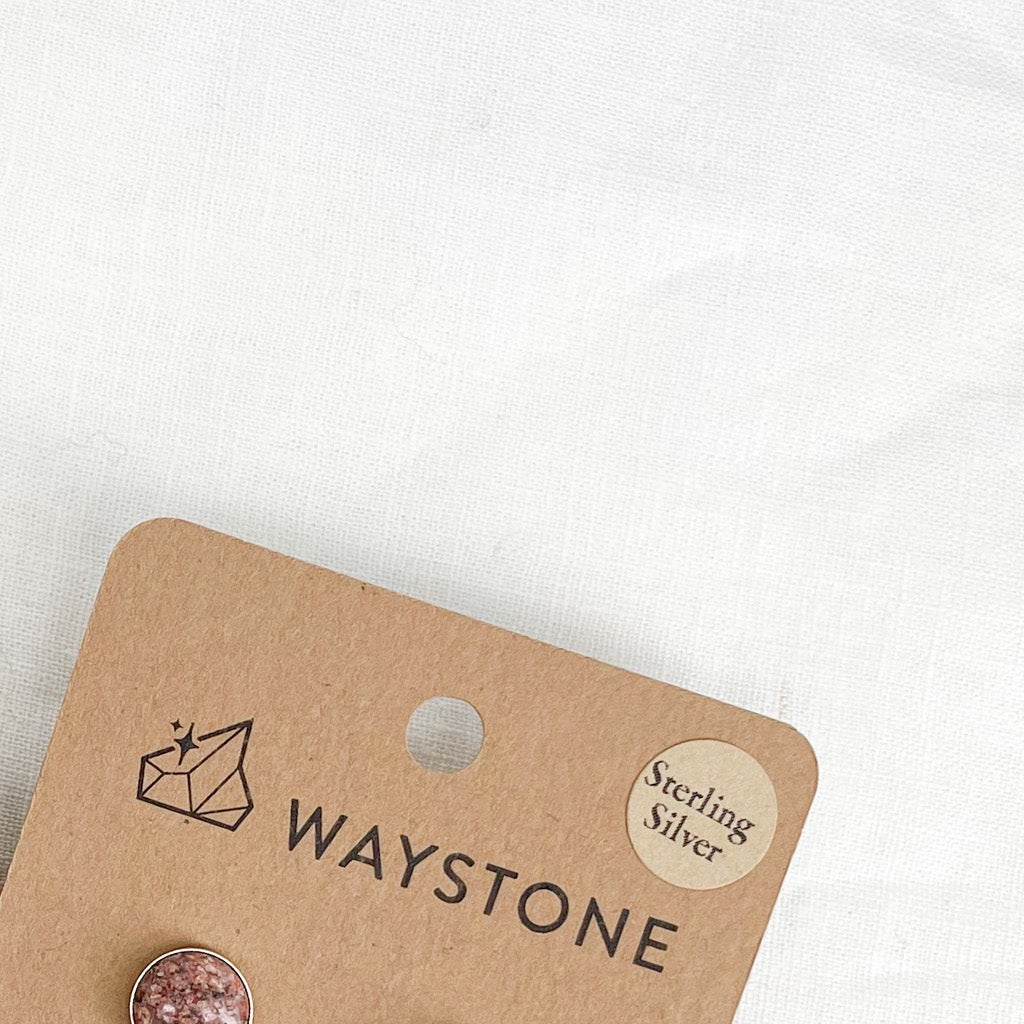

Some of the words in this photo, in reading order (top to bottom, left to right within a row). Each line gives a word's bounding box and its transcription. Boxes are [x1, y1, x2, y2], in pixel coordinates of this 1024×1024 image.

[642, 802, 724, 863] Silver
[644, 760, 756, 846] Sterling
[287, 798, 679, 974] WAYSTONE
